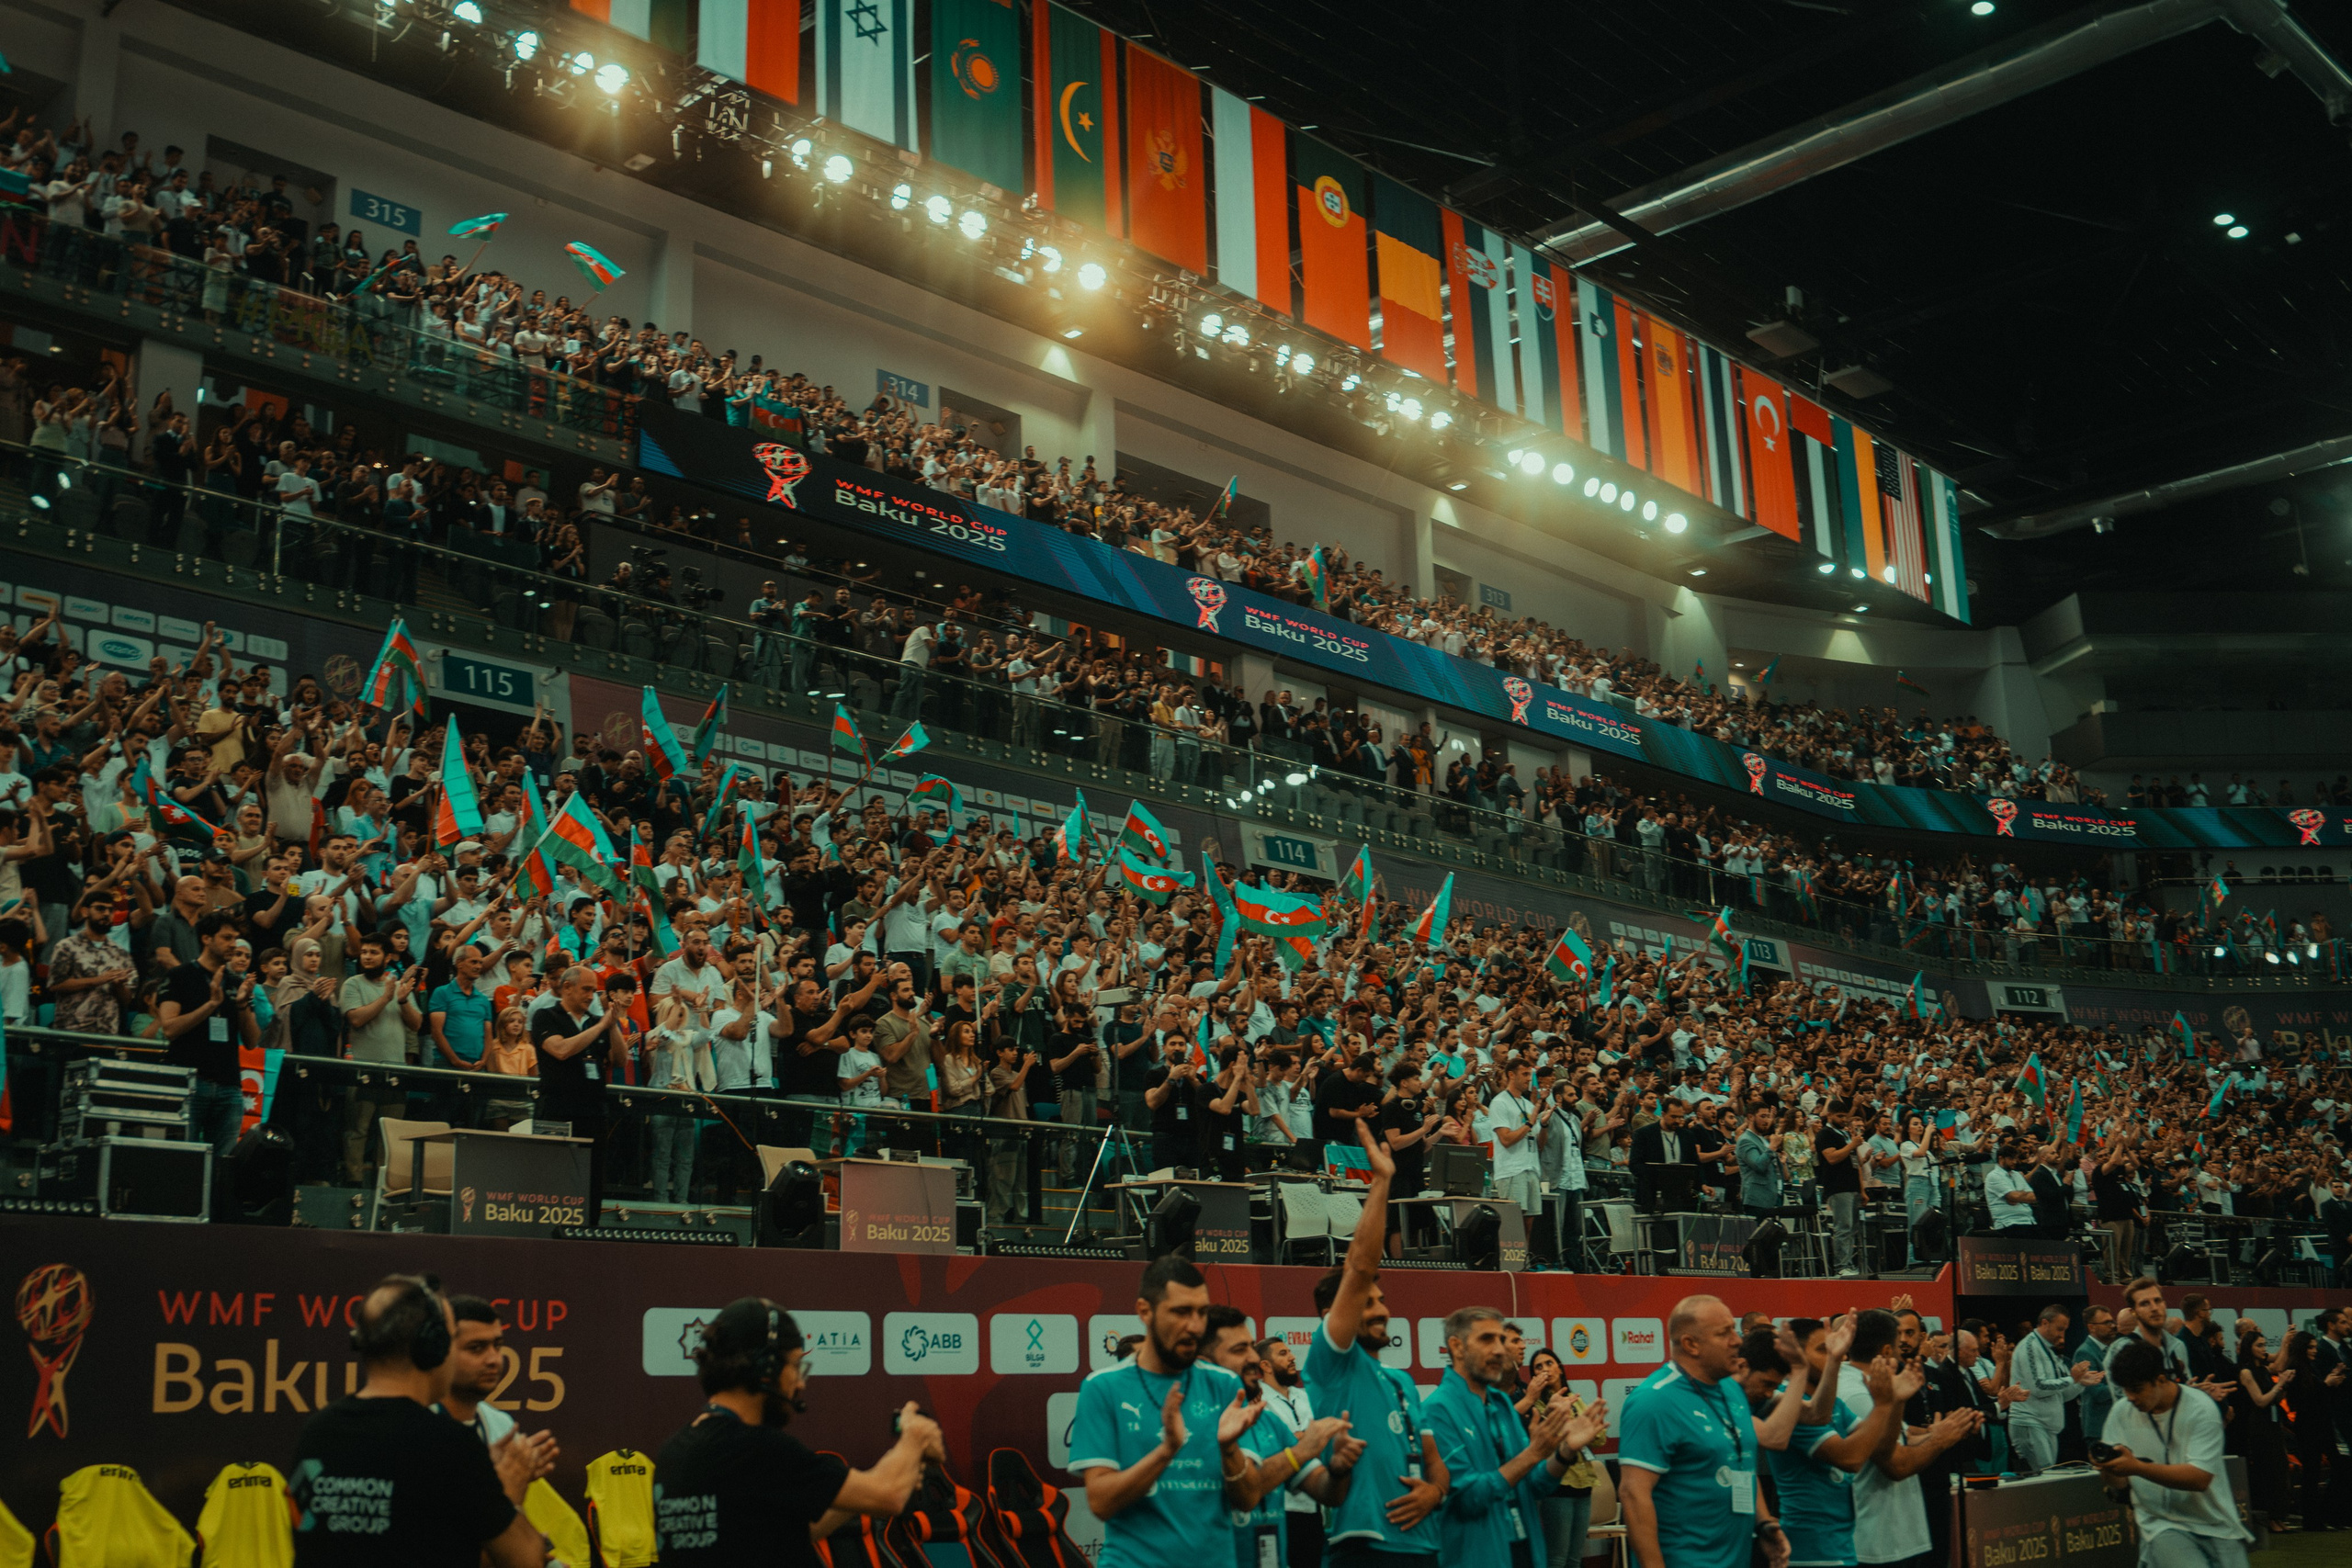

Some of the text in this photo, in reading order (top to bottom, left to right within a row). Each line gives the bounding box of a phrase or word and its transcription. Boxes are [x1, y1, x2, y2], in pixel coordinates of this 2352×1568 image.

[365, 197, 406, 227] 315
[235, 289, 375, 362] #MGA
[888, 377, 919, 400] 314
[835, 478, 1008, 536] WMF WORLD CUP
[834, 489, 1007, 551] Baku 2025
[1486, 588, 1505, 606] 313
[1244, 605, 1370, 649] WMF WORLD CUP
[1244, 614, 1370, 662] Baku 2025
[462, 663, 514, 696] 115
[1545, 700, 1642, 735] WMF WORLD CUP
[1545, 707, 1642, 746] Baku 2025
[1776, 778, 1856, 810] Baku 2025
[2032, 818, 2137, 837] Baku 2025
[2064, 816, 2107, 825] WORLD
[1275, 840, 1306, 862] 114
[1454, 897, 1519, 924] WORLD
[1523, 909, 1557, 931] CUP
[1749, 941, 1771, 961] 113
[2014, 990, 2040, 1005] 112
[486, 1190, 585, 1206] WMF WORLD CUP
[485, 1202, 584, 1225] Baku 2025
[867, 1224, 951, 1242] Baku 2025
[1194, 1236, 1250, 1254] aku 2025
[1502, 1249, 1526, 1262] 2025
[1975, 1262, 2018, 1280] Baku 2025
[2030, 1264, 2071, 1280] Baku 2025
[158, 1289, 277, 1326] WMF
[930, 1334, 961, 1348] ABB
[1288, 1332, 1312, 1345] EVRAS
[1628, 1330, 1654, 1344] Rahat
[153, 1338, 358, 1414] Baku
[228, 1474, 272, 1488] erima
[312, 1476, 394, 1497] COMMON
[310, 1495, 392, 1517] CREATIVE
[327, 1514, 391, 1534] GROUP
[2065, 1523, 2122, 1553] Baku 2025
[1984, 1536, 2048, 1567] Baku 2025
